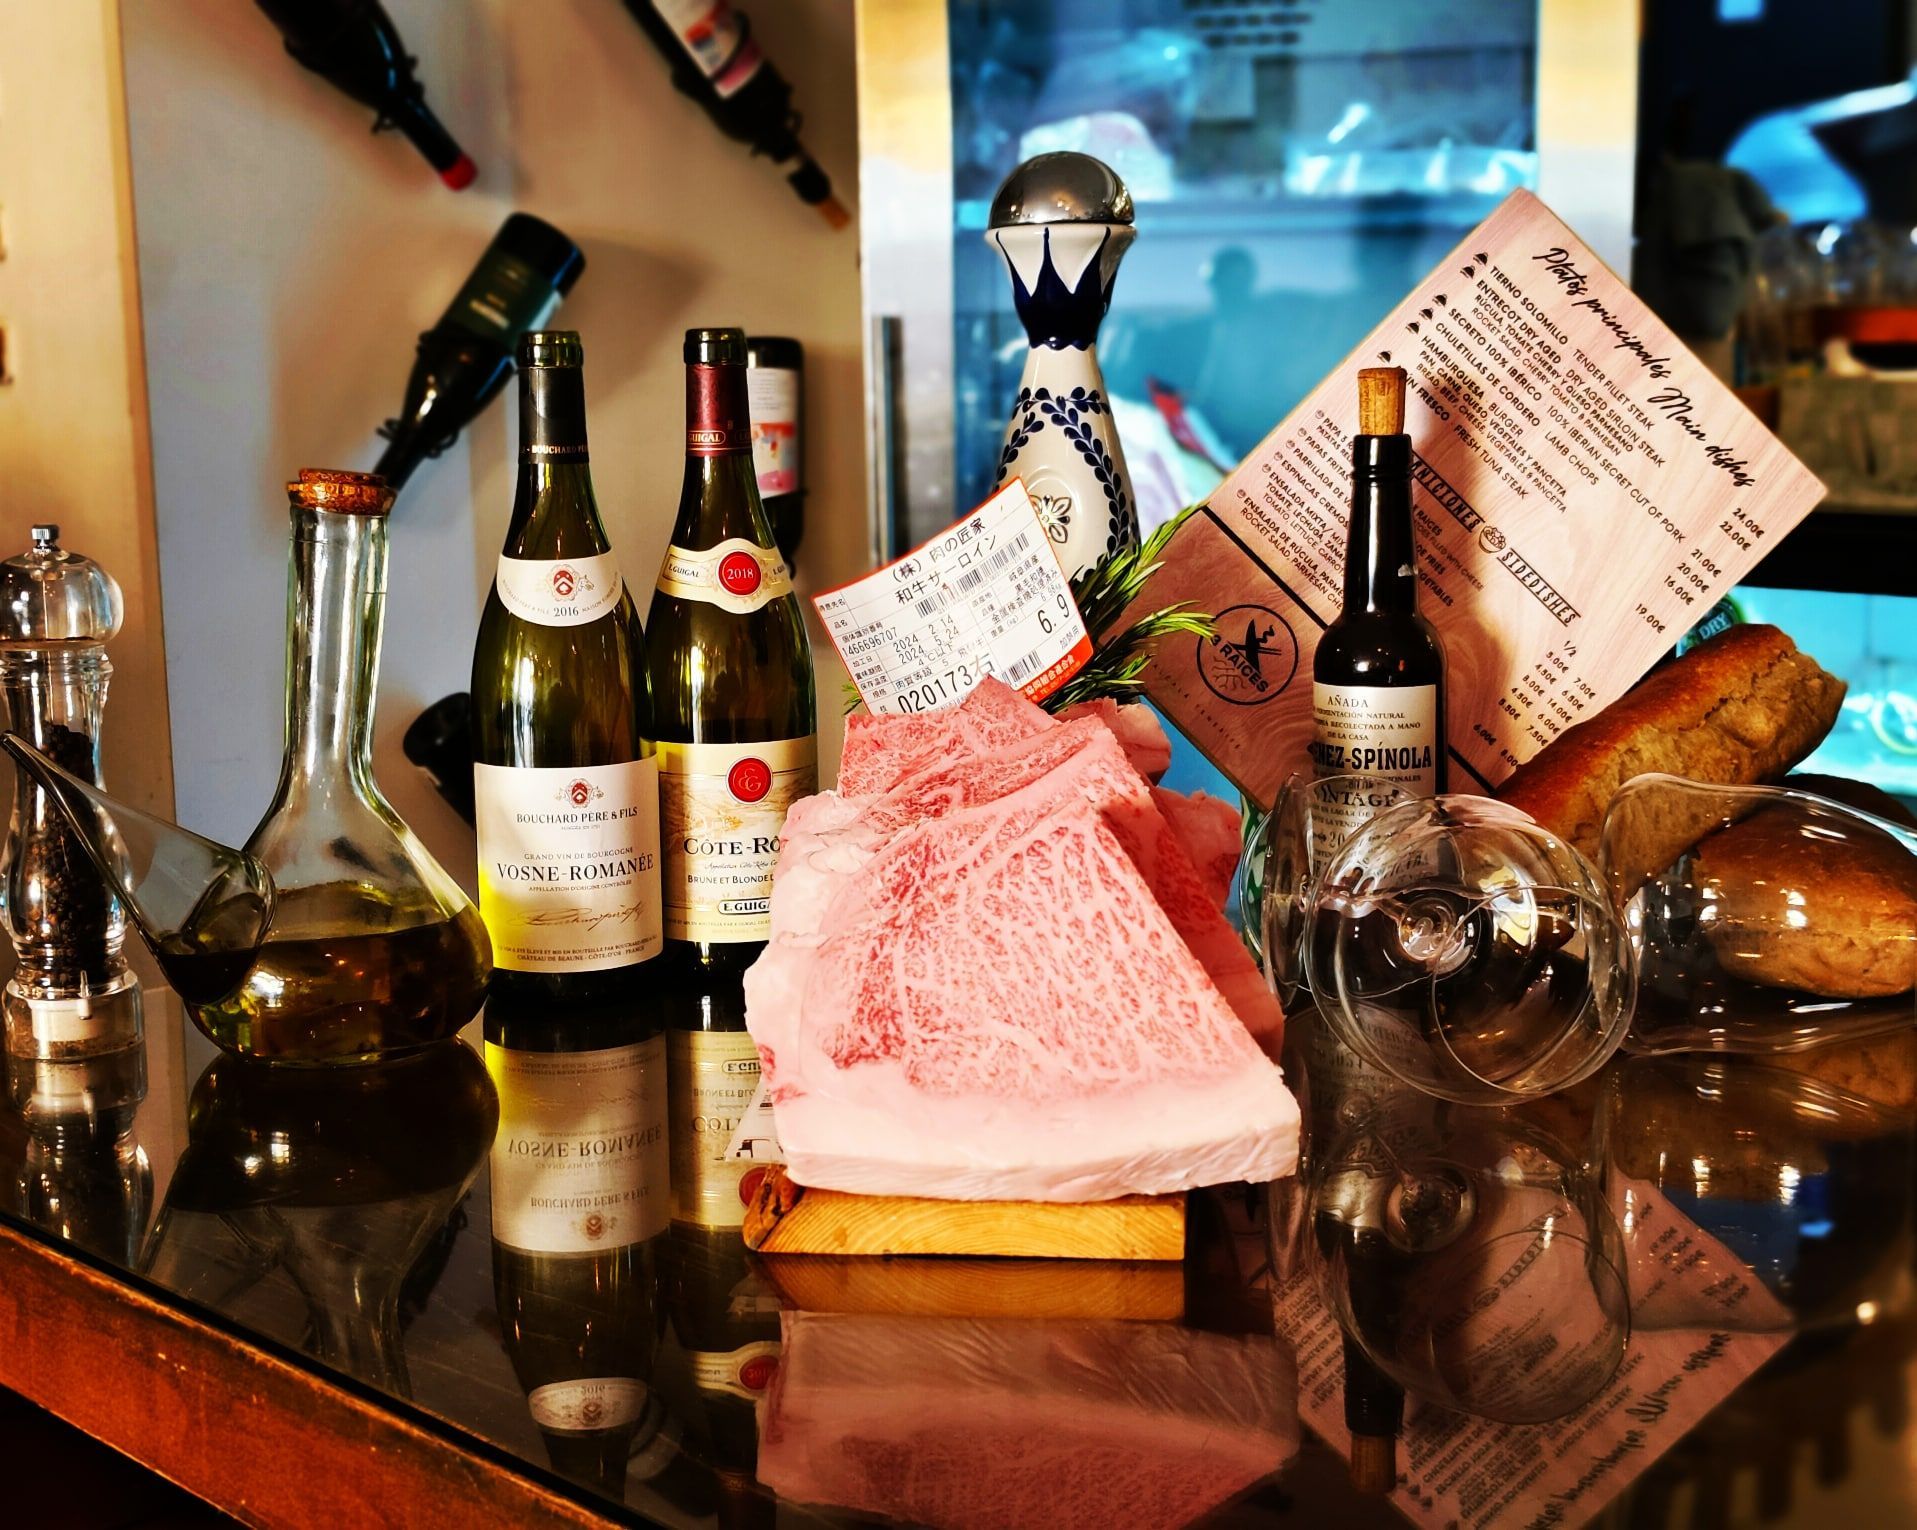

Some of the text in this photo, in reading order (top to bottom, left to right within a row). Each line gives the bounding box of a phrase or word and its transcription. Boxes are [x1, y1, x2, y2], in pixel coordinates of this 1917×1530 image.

[1471, 307, 1501, 336] ROCKET
[1498, 334, 1522, 361] SALAD,
[1522, 358, 1550, 386] CHERRY
[1549, 383, 1579, 415] TOMATO
[1583, 418, 1621, 457] PARMESAN
[1474, 294, 1634, 452] RÚCULA, TOMATE CHERRY Y QUESO PARMESANO
[1490, 265, 1764, 539] TIERNO SOLOMILLO TENDER FILLET STEAK 24.00€
[1531, 247, 1756, 488] Platos principales Main dishes
[1322, 417, 1342, 437] PAPA
[1416, 363, 1440, 390] BREAD,
[1486, 431, 1528, 474] VEGETABLES
[1531, 477, 1567, 513] PANCETTA
[1419, 350, 1436, 369] PAN,
[1489, 418, 1527, 457] VEGETALES
[1530, 460, 1567, 497] PANCETTA
[1448, 308, 1721, 578] SECRETO 100% IBÉRICO 100% IBERIAN SECRET CUT OF PORK 21.00€
[1476, 279, 1751, 552] ENTRECOT DRY AGED DRY AGED SIRLOIN STEAK 22.00€
[1280, 459, 1320, 498] ESPINACAS
[1304, 435, 1328, 458] PAPAS
[1326, 456, 1350, 481] FRITAS
[1420, 335, 1485, 400] HAMBURGUESA
[1488, 402, 1523, 438] BURGER
[1663, 574, 1694, 606] 16.00€
[1435, 322, 1709, 594] CHULETILLAS DE CORDERO LAMB CHOPS 20.00€
[1243, 496, 1280, 533] ENSALADA
[1278, 531, 1292, 545] DE
[1290, 542, 1319, 575] RÚCULA,
[1415, 386, 1665, 634] FRESCO FRESH TUNA STEAK 19.00€
[727, 568, 753, 579] 2018
[894, 534, 997, 606] 和牛サーロイン
[1240, 507, 1269, 537] ROCKET
[1290, 557, 1328, 595] PARMESAN
[1292, 447, 1334, 489] PARRILLADA
[1332, 486, 1344, 499] DE
[1546, 697, 1572, 723] 14.00€
[1316, 424, 1341, 449] PATATAS
[1459, 567, 1484, 591] CHEESE
[1573, 676, 1596, 700] 7.00€
[1500, 551, 1576, 626] SIDEDISHES
[554, 606, 578, 617] 2016
[841, 626, 898, 658] 1466696707
[945, 625, 959, 639] 24
[1209, 634, 1222, 646] 3
[1268, 471, 1306, 508] ENSALADA
[1525, 724, 1548, 747] 7.50€
[1698, 613, 1732, 640] DRY
[1328, 695, 1368, 708] AÑADA
[1331, 721, 1385, 729] RECOLECTADA
[1397, 721, 1421, 729] MANO
[517, 813, 578, 824] BOUCHARD
[620, 807, 638, 818] FILS
[587, 847, 633, 858] BOURGOGNE
[497, 852, 653, 881] VOSNE-ROMANÉE
[688, 874, 769, 884] BRUNE ET BLONDE
